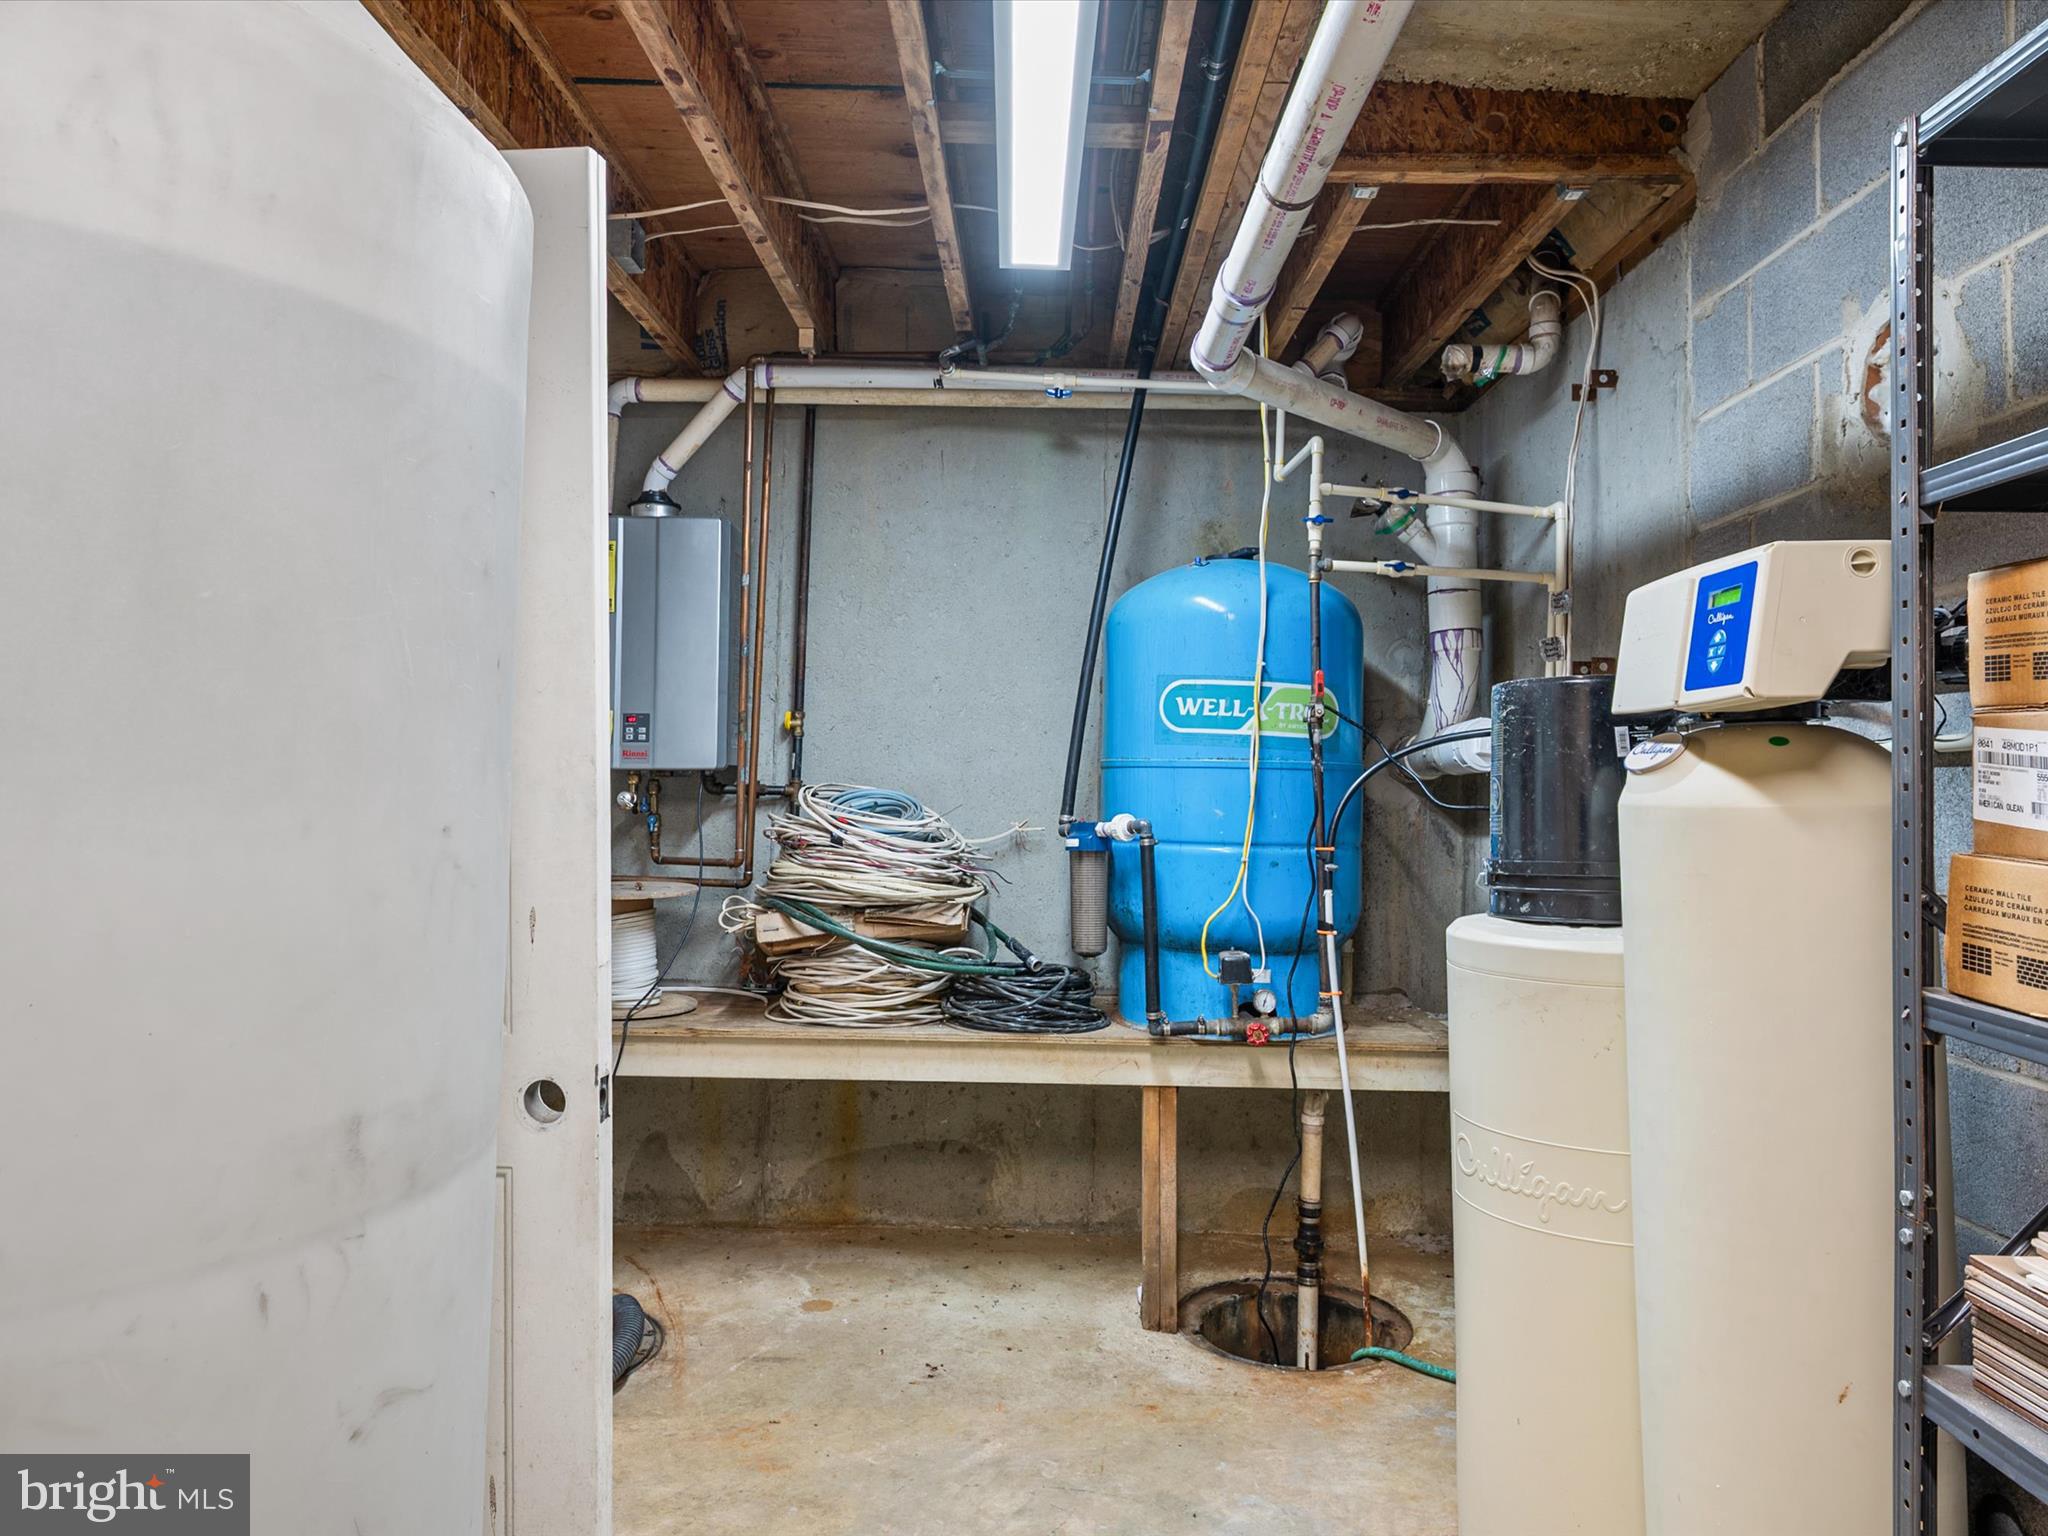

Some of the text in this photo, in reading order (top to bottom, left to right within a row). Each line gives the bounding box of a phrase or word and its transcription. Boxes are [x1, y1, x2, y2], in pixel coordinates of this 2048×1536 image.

[1985, 590, 2046, 605] CERAMIC WALL TILE
[1985, 606, 2012, 615] AZULEJO
[2013, 604, 2021, 612] DE
[1708, 612, 1734, 625] Culligan
[1985, 615, 2017, 624] CARREAUX
[2018, 611, 2045, 621] MURAUX
[622, 749, 649, 758] Rinnai
[1633, 741, 1674, 760] Culligan
[1964, 885, 2032, 902] CERAMIC WALL TILE
[1964, 895, 1994, 905] AZULEJO
[1963, 904, 2000, 916] CARREAUX
[2001, 911, 2031, 923] MURAUX
[2032, 917, 2043, 925] EN
[1456, 1132, 1628, 1224] Culligan
